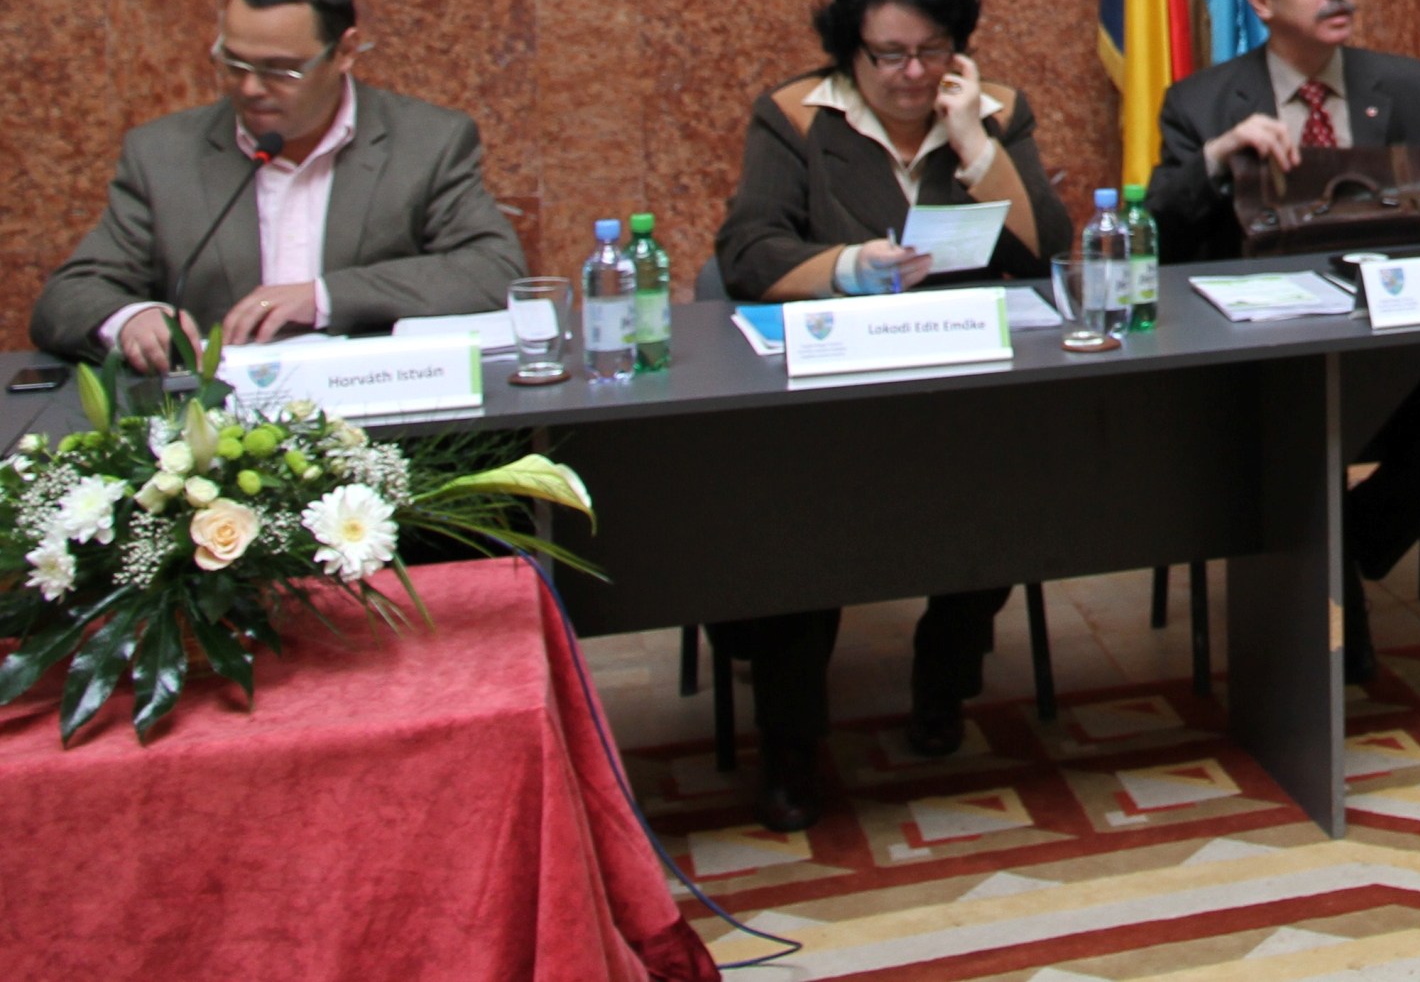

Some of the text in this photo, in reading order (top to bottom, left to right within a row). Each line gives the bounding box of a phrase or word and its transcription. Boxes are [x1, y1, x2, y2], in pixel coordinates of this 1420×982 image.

[914, 320, 939, 333] Edit
[328, 365, 445, 389] Horváth István
